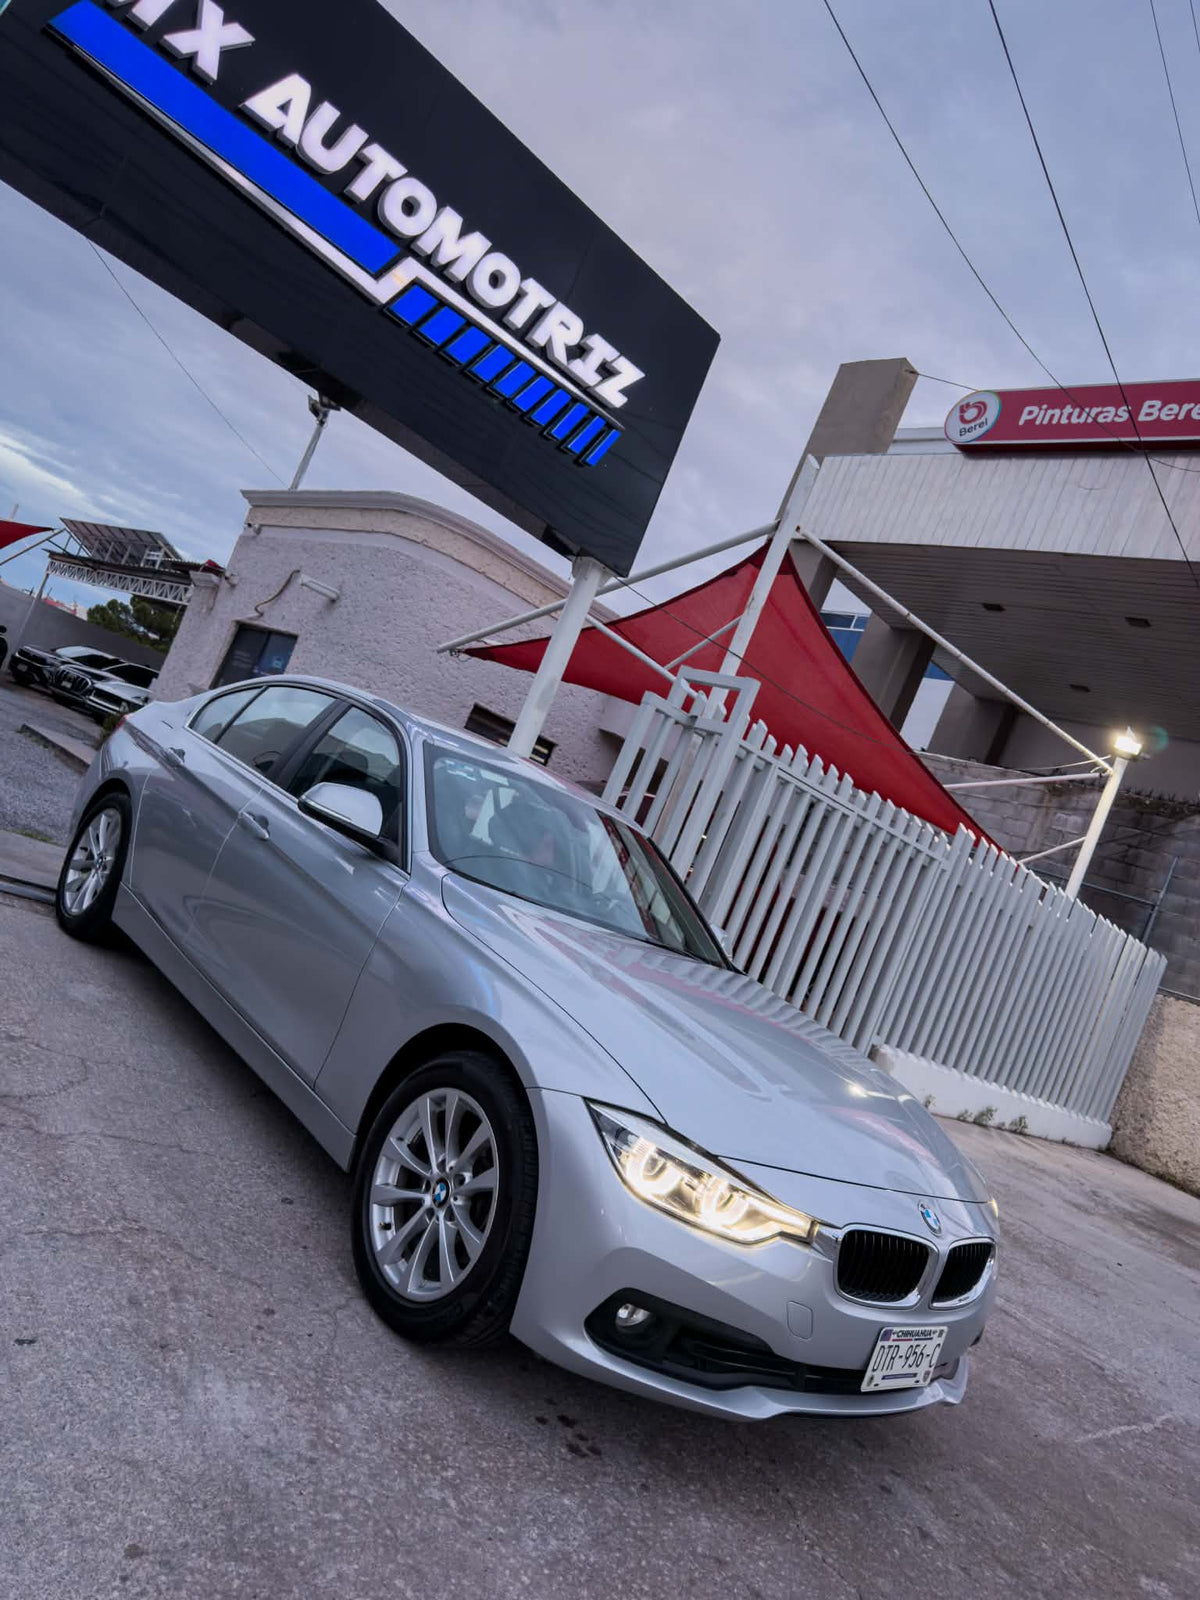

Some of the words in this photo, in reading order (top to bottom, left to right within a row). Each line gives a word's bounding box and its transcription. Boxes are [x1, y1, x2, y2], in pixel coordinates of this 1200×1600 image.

[239, 73, 645, 409] AUTOMOTRIZ
[1018, 404, 1132, 426] Pinturas
[959, 417, 988, 437] Berel
[896, 1329, 932, 1338] CHIHUAHUA
[871, 1343, 941, 1373] DTR-956-C
